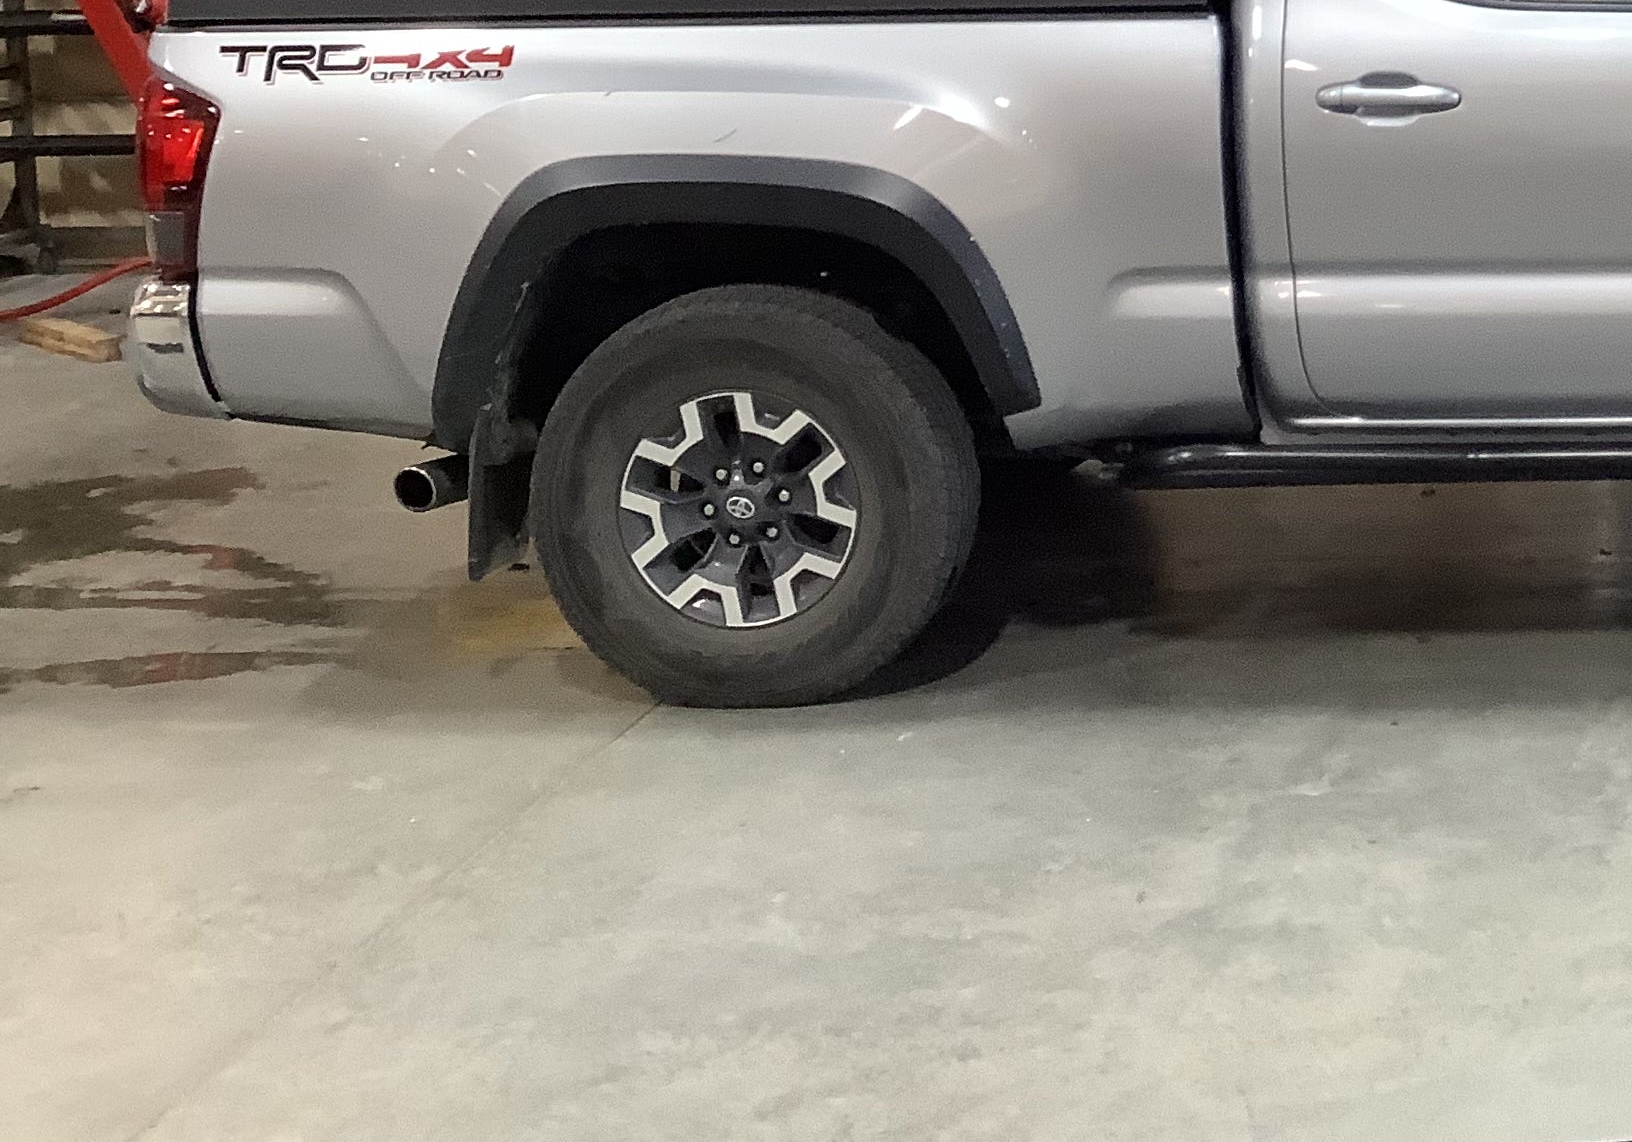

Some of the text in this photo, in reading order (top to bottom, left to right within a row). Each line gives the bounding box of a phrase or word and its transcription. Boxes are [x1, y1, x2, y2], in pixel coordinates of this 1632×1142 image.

[219, 43, 370, 85] TRD
[370, 68, 504, 82] OFF ROAD
